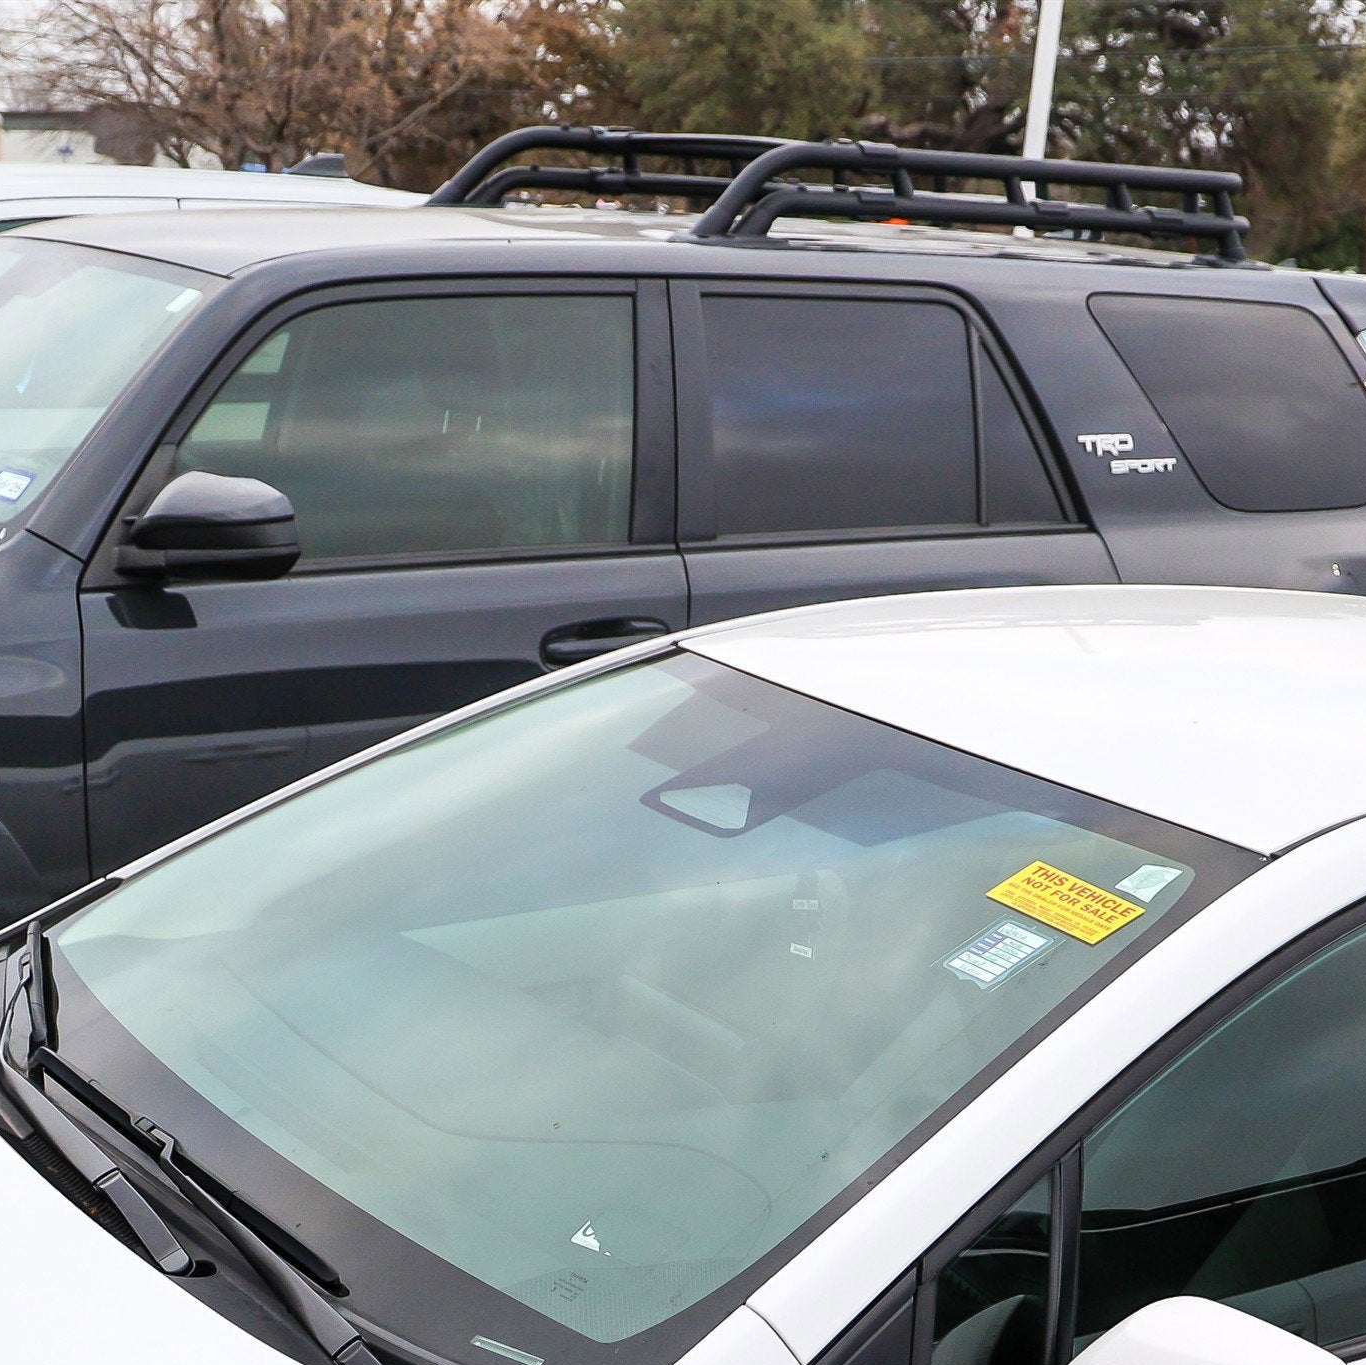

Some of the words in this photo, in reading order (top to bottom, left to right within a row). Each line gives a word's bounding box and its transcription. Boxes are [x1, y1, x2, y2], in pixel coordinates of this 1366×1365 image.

[1110, 458, 1178, 475] SPORT
[1021, 877, 1052, 893] NOT
[1050, 890, 1081, 906] FOR
[1080, 904, 1119, 924] SALE
[1031, 866, 1069, 886] THIS
[1068, 882, 1136, 918] VEHICLE
